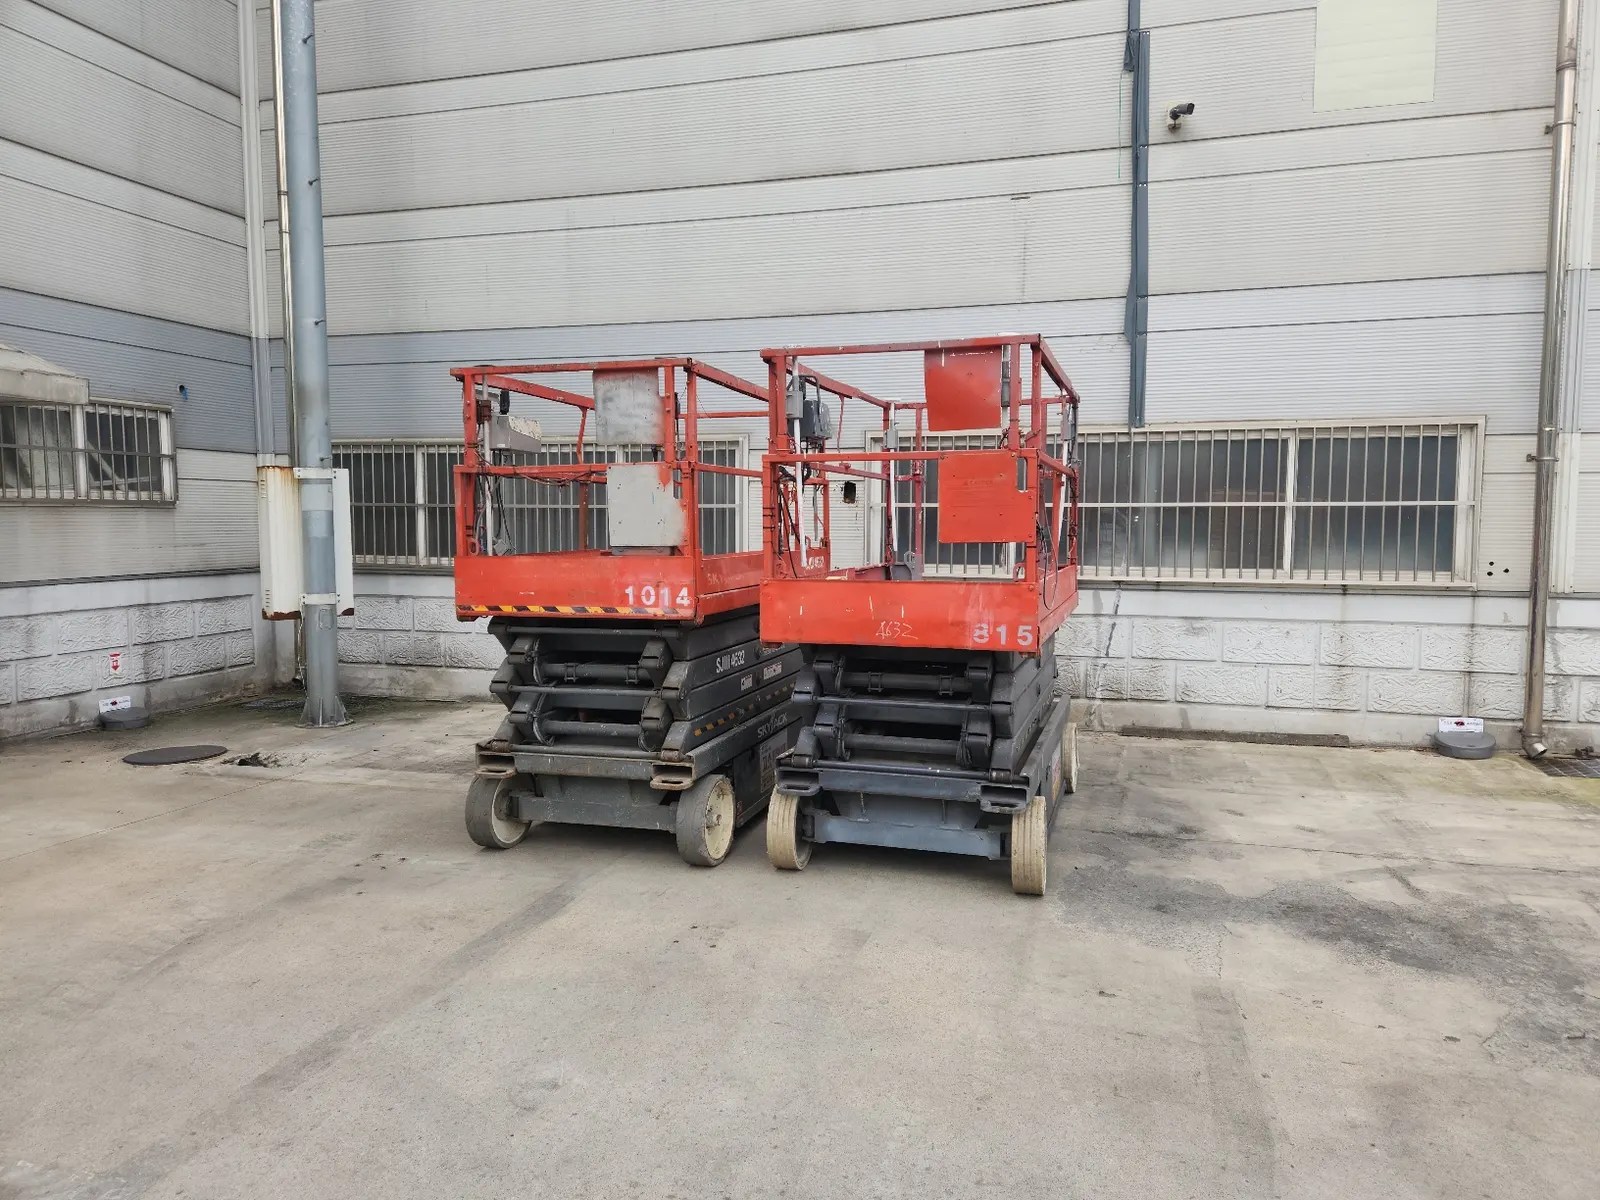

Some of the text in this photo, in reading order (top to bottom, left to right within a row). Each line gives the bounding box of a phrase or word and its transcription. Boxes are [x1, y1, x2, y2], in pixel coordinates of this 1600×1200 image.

[624, 585, 691, 607] 1014
[972, 623, 1034, 647] 815
[731, 650, 745, 668] 4632
[757, 712, 788, 738] SKYJACK
